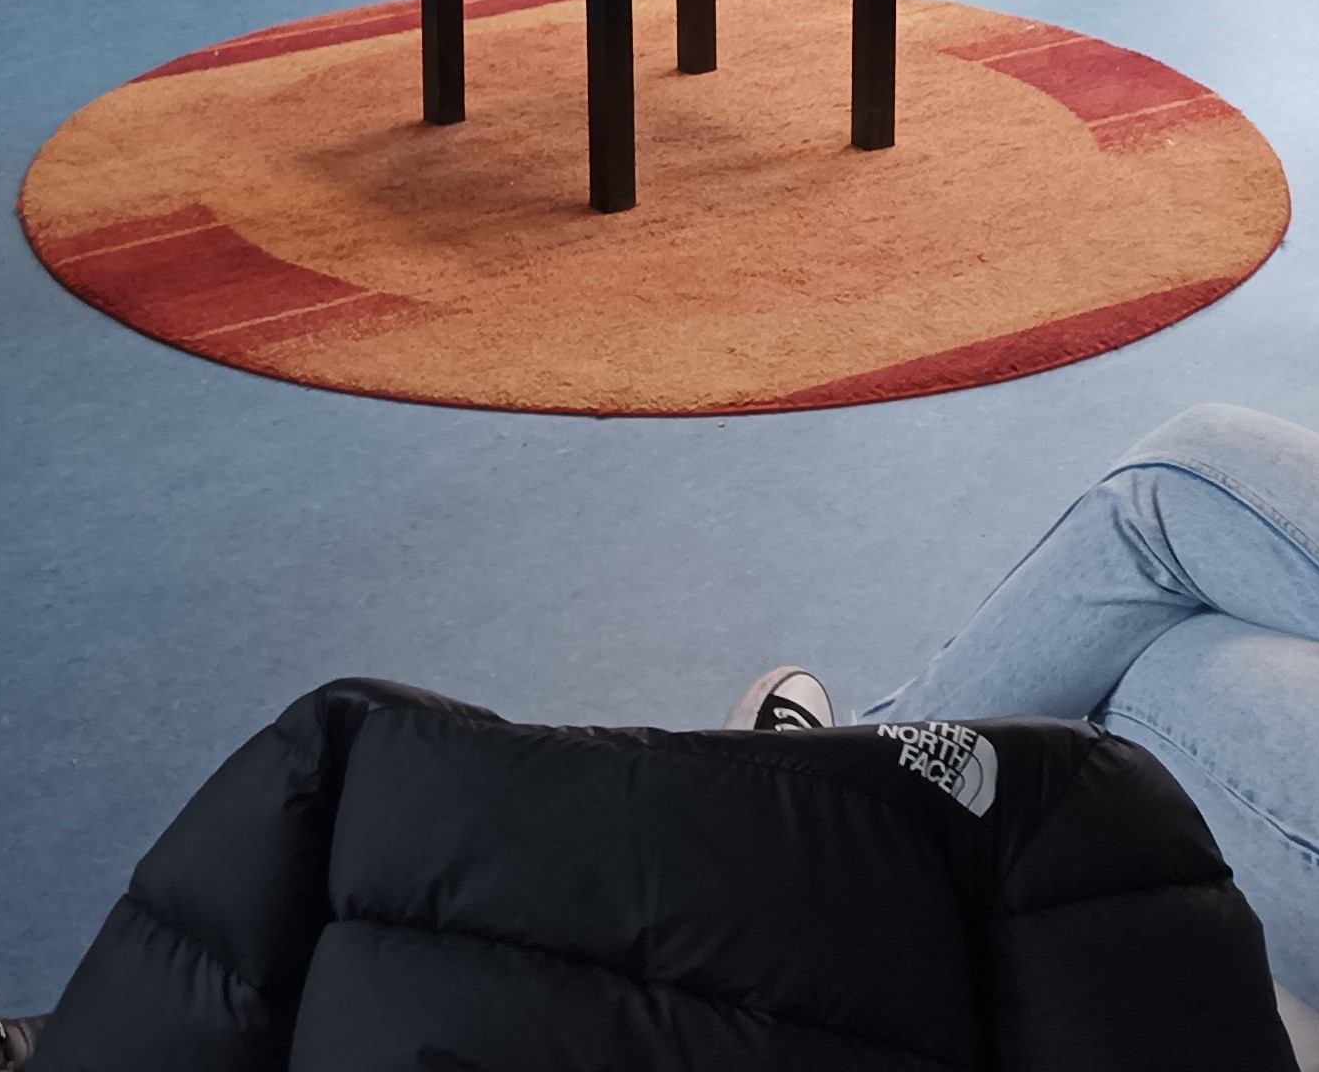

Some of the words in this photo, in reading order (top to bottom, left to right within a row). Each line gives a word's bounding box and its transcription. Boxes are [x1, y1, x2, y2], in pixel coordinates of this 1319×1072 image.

[877, 724, 971, 770] NORTH
[926, 721, 977, 751] THE
[898, 743, 959, 795] FACE
